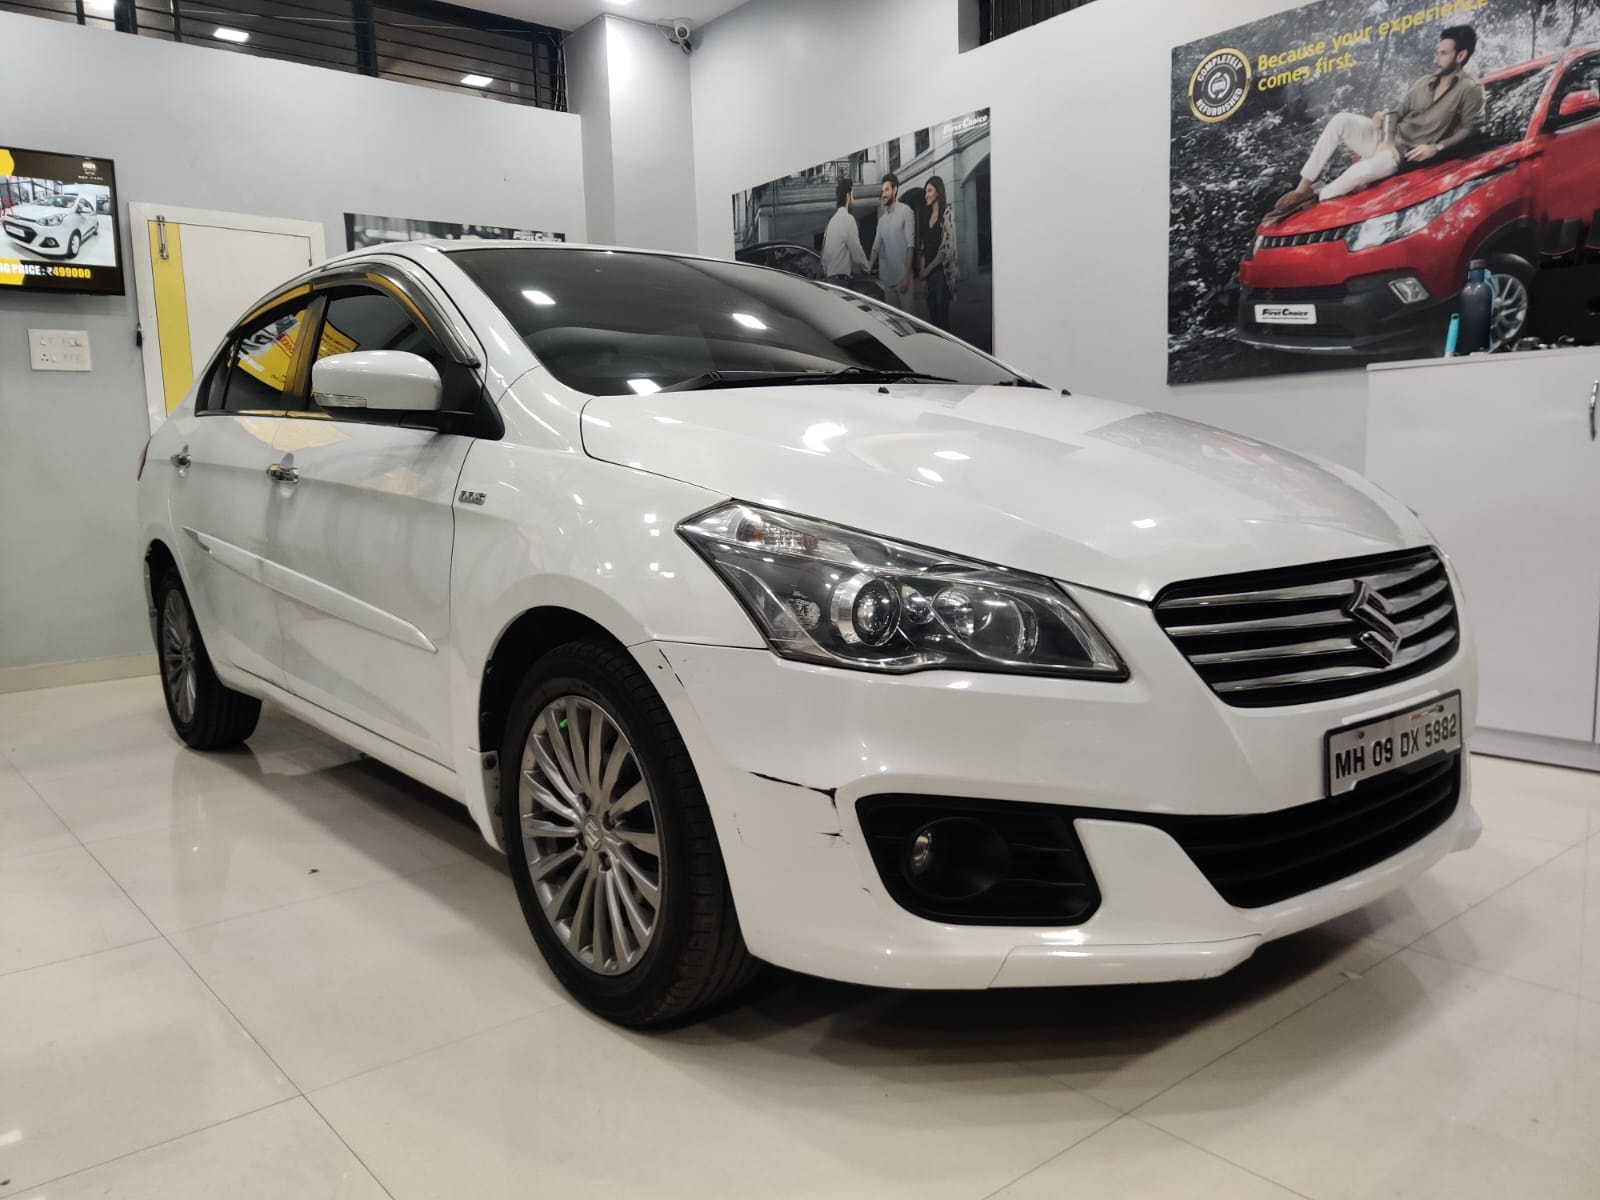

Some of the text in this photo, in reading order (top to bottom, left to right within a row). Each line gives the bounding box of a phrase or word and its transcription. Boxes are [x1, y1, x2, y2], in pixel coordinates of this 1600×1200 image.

[1258, 41, 1326, 72] Because
[1332, 26, 1372, 53] your
[1197, 54, 1243, 82] COMPLETELY
[1258, 65, 1310, 91] comes
[1195, 87, 1243, 117] REFURBISHED
[1335, 713, 1457, 779] MH 09 DX 5982
